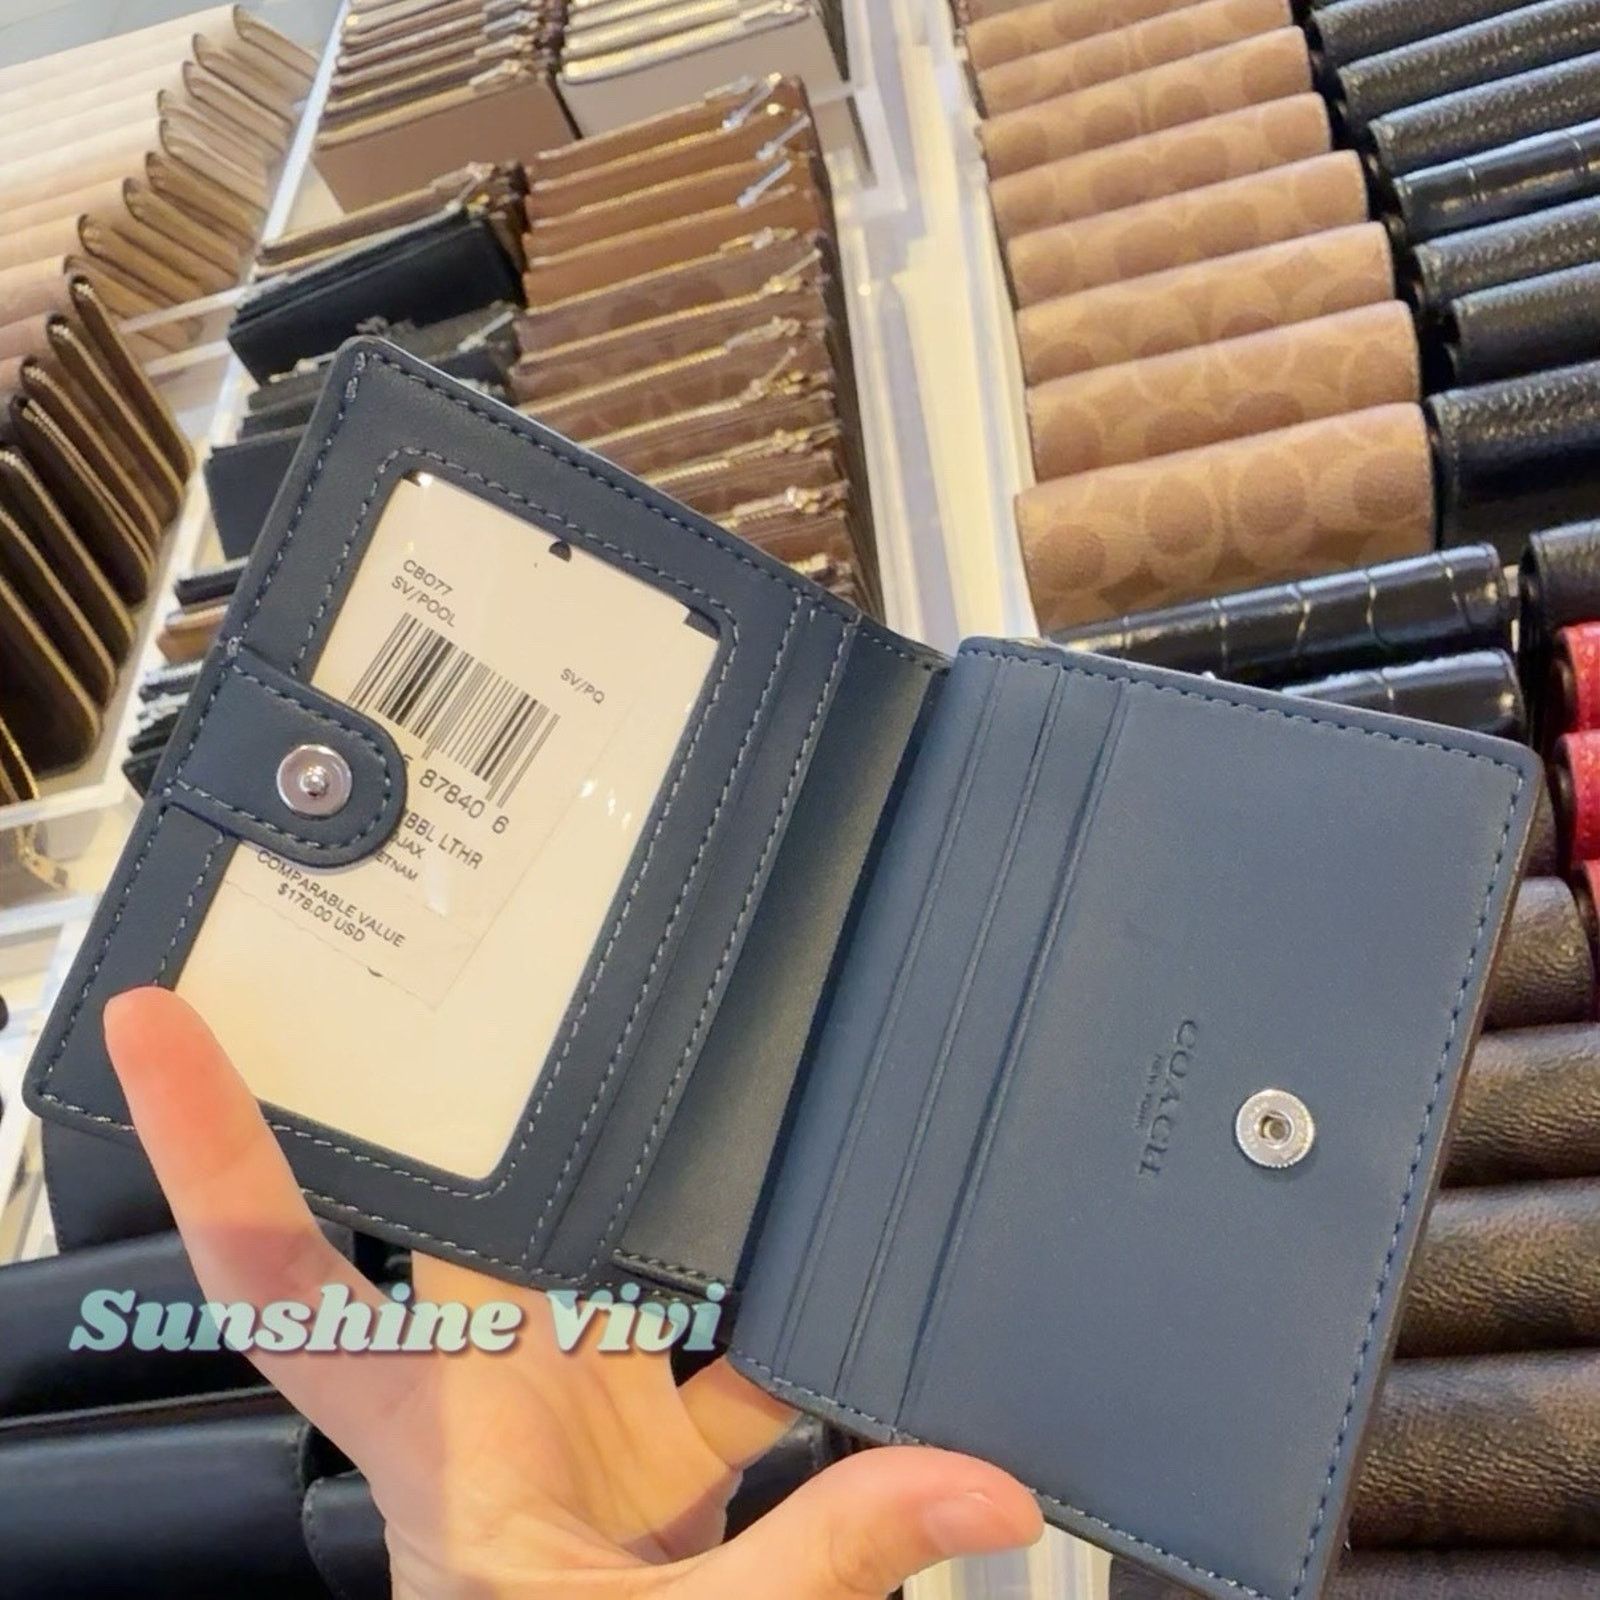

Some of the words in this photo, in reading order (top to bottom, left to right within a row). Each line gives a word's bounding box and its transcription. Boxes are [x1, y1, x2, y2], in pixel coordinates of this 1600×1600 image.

[391, 574, 456, 628] SV/POOL
[559, 667, 606, 705] SV/PQ
[418, 768, 486, 819] 87840
[491, 815, 510, 834] 6
[375, 849, 419, 882] ETNAM
[400, 808, 435, 843] BBL
[438, 832, 484, 870] LTHR
[256, 849, 358, 919] COMPARABLE
[358, 911, 406, 948] VALUE
[277, 882, 334, 923] $178.00
[333, 915, 367, 943] USD
